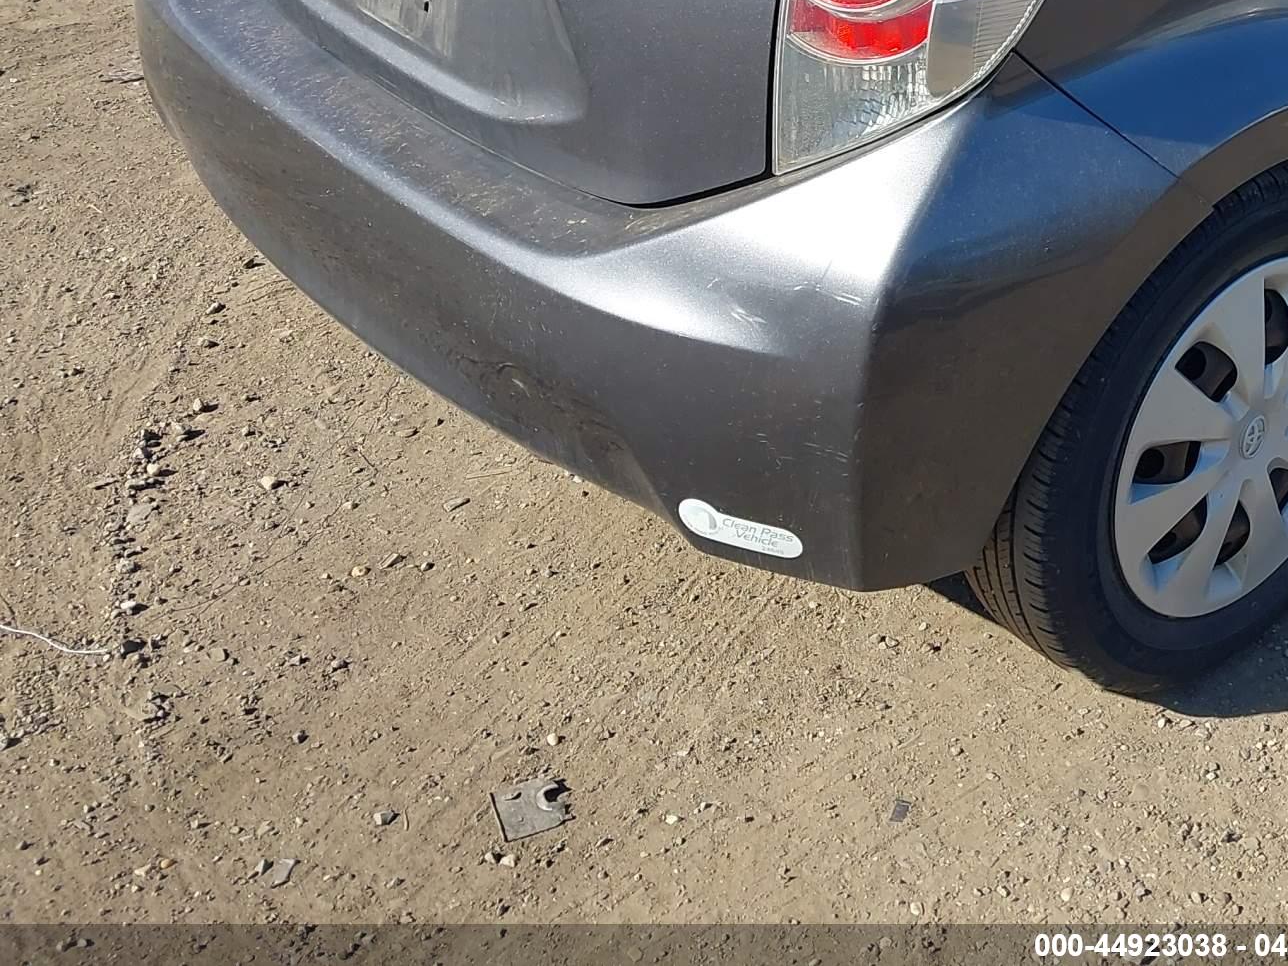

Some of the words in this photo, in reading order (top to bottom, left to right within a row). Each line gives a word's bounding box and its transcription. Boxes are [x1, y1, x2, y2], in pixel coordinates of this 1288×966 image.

[722, 518, 757, 534] Clean
[761, 527, 794, 543] Pass
[736, 529, 779, 548] Vehicle
